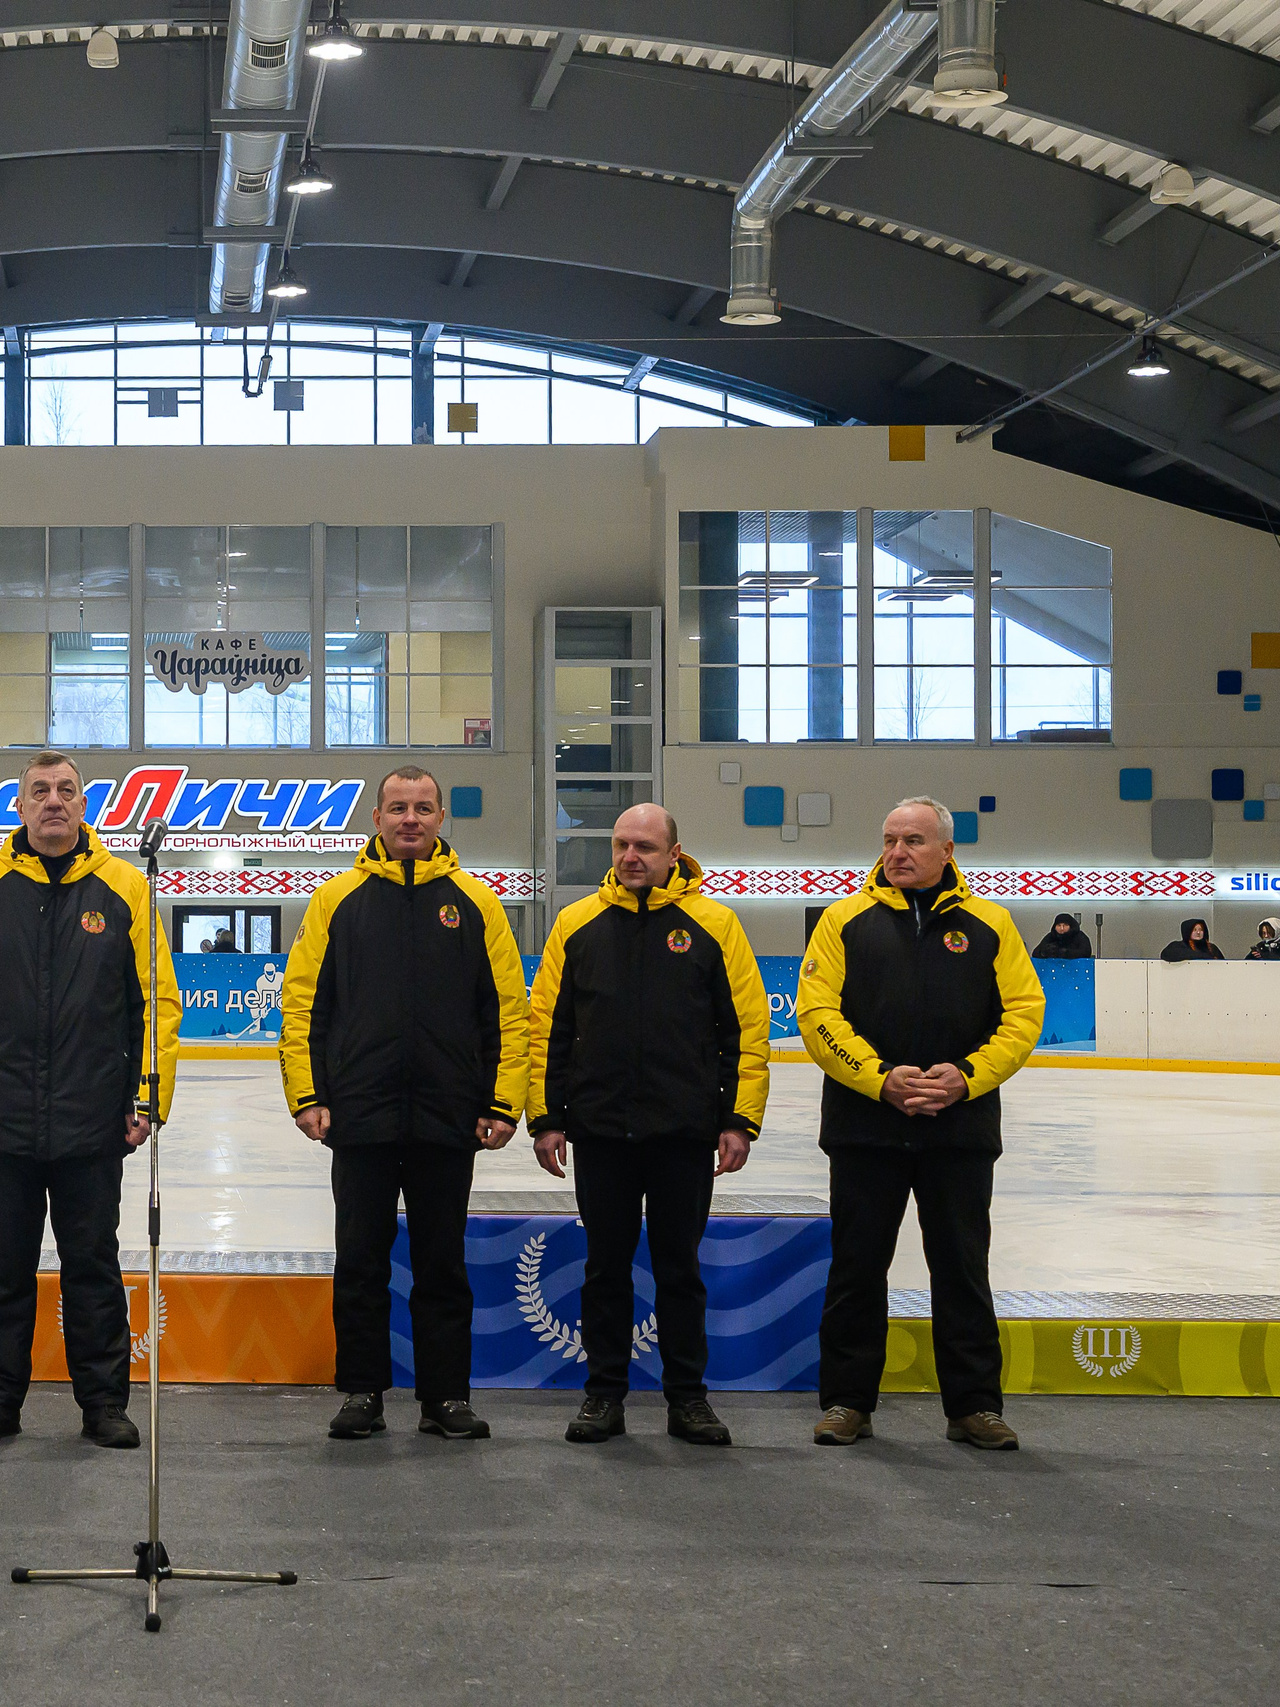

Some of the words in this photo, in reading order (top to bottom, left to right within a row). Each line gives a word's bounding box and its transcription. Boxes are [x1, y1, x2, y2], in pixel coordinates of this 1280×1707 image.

[201, 638, 257, 651] КАФЕ
[154, 649, 304, 688] Чараўніца
[163, 835, 306, 848] ГОРНОЛЫЖНЫЙ
[310, 837, 366, 850] ЦЕНТР
[816, 1023, 863, 1072] BELARUS
[1083, 1327, 1131, 1358] III
